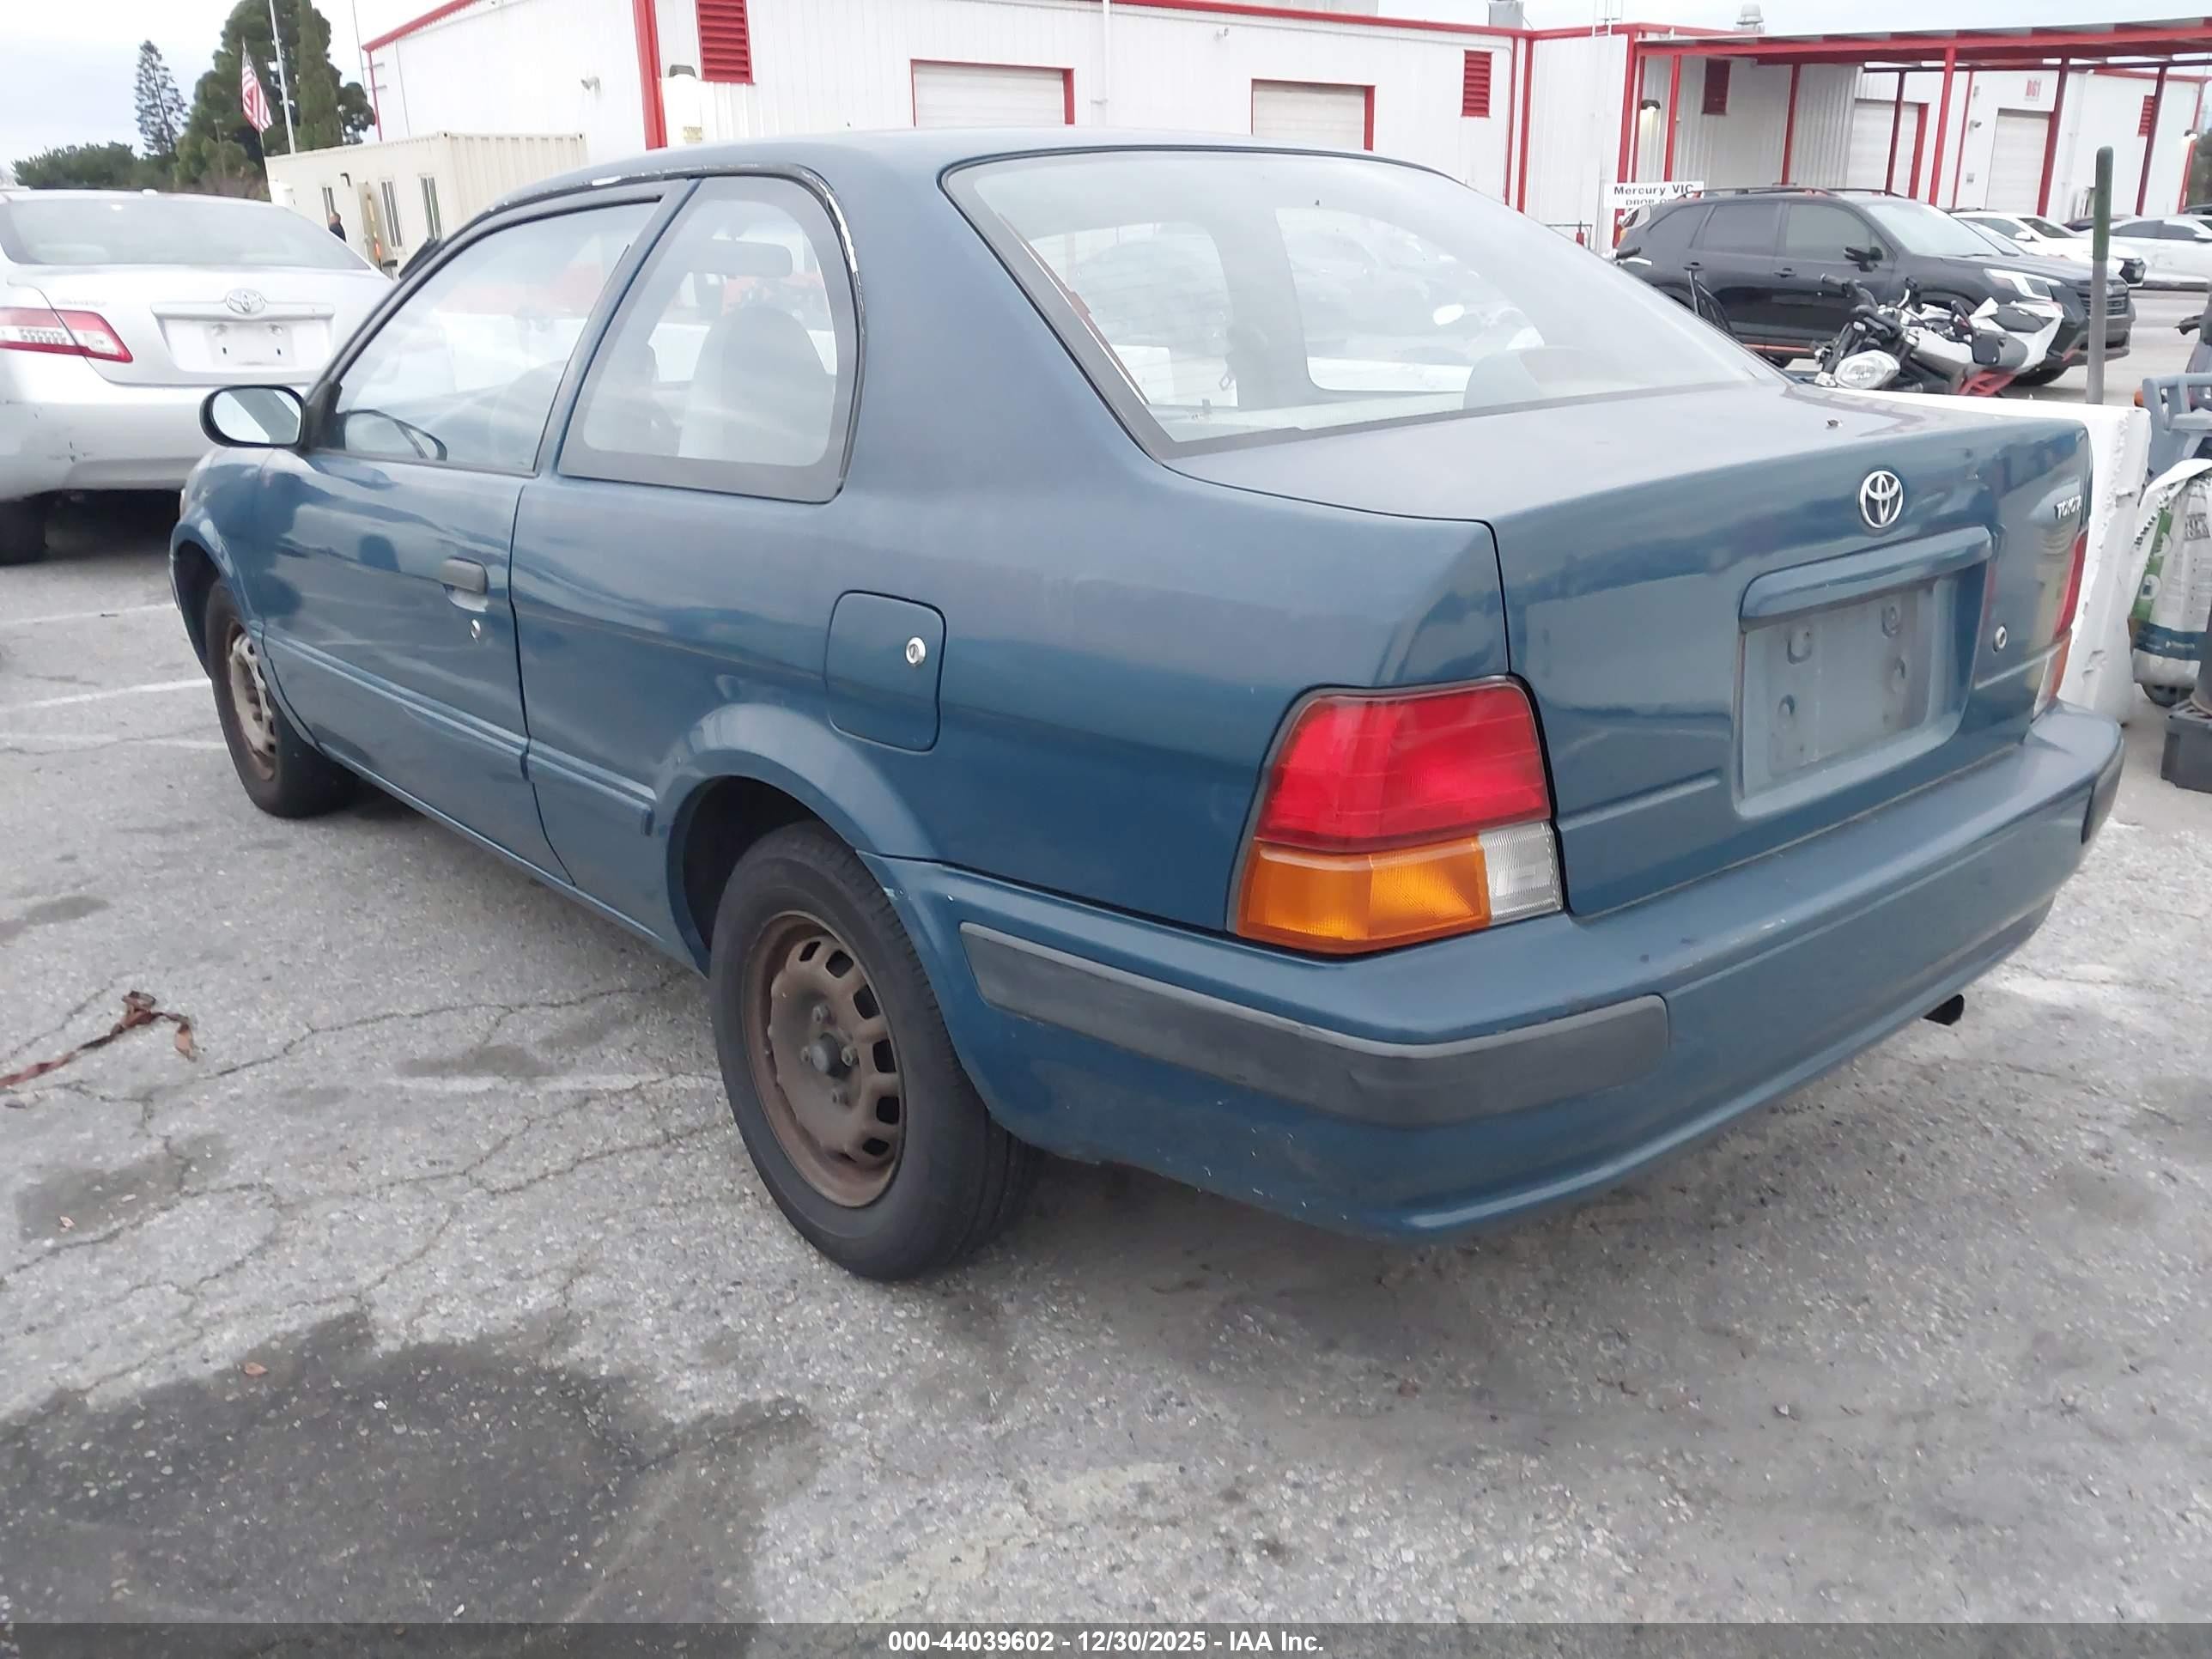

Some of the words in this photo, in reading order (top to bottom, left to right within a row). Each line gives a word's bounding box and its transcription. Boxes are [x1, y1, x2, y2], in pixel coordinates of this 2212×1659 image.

[1614, 185, 1666, 196] Mercury
[1672, 184, 1693, 193] VIC
[2055, 495, 2081, 520] TOYOT
